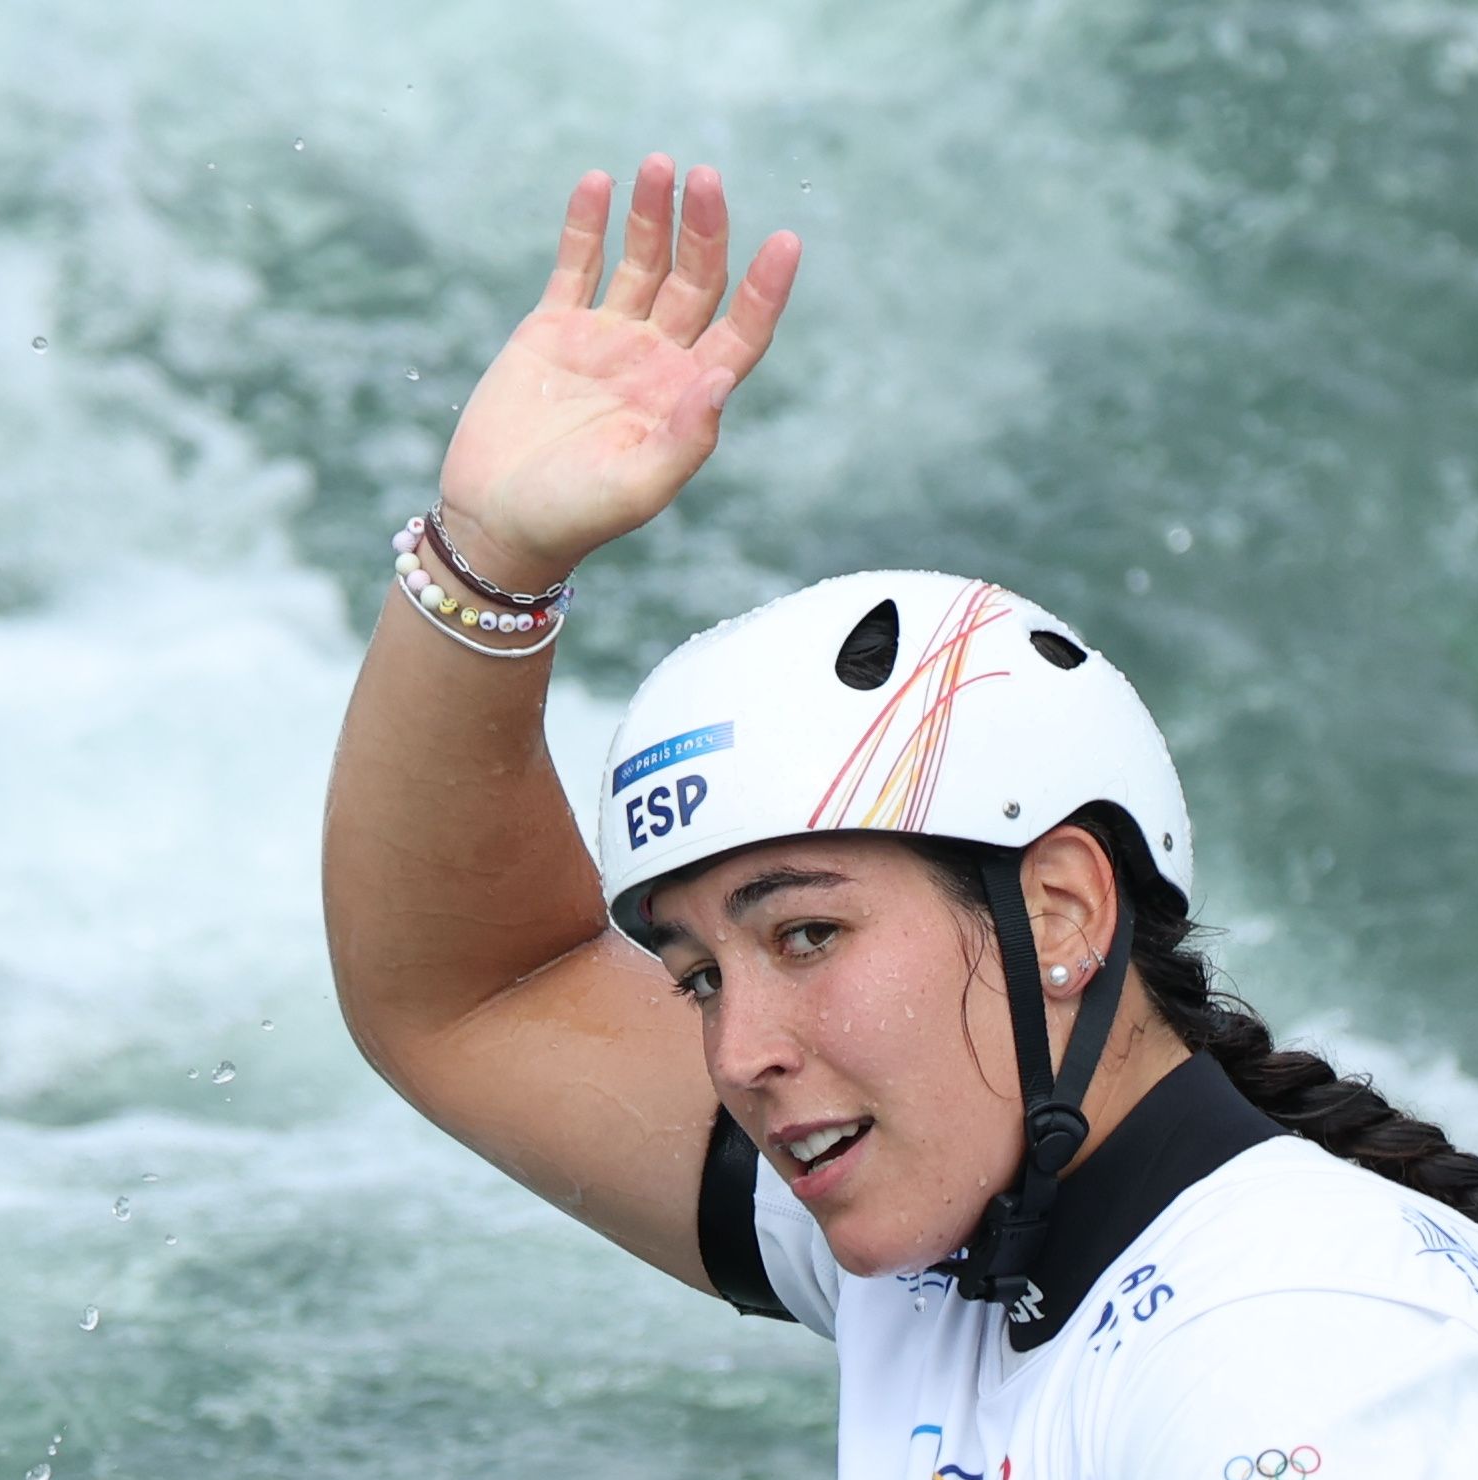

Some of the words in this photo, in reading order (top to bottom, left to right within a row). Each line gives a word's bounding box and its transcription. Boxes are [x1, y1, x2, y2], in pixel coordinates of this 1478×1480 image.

[636, 748, 671, 772] PARIS
[675, 735, 713, 755] 2024
[627, 775, 707, 850] ESP
